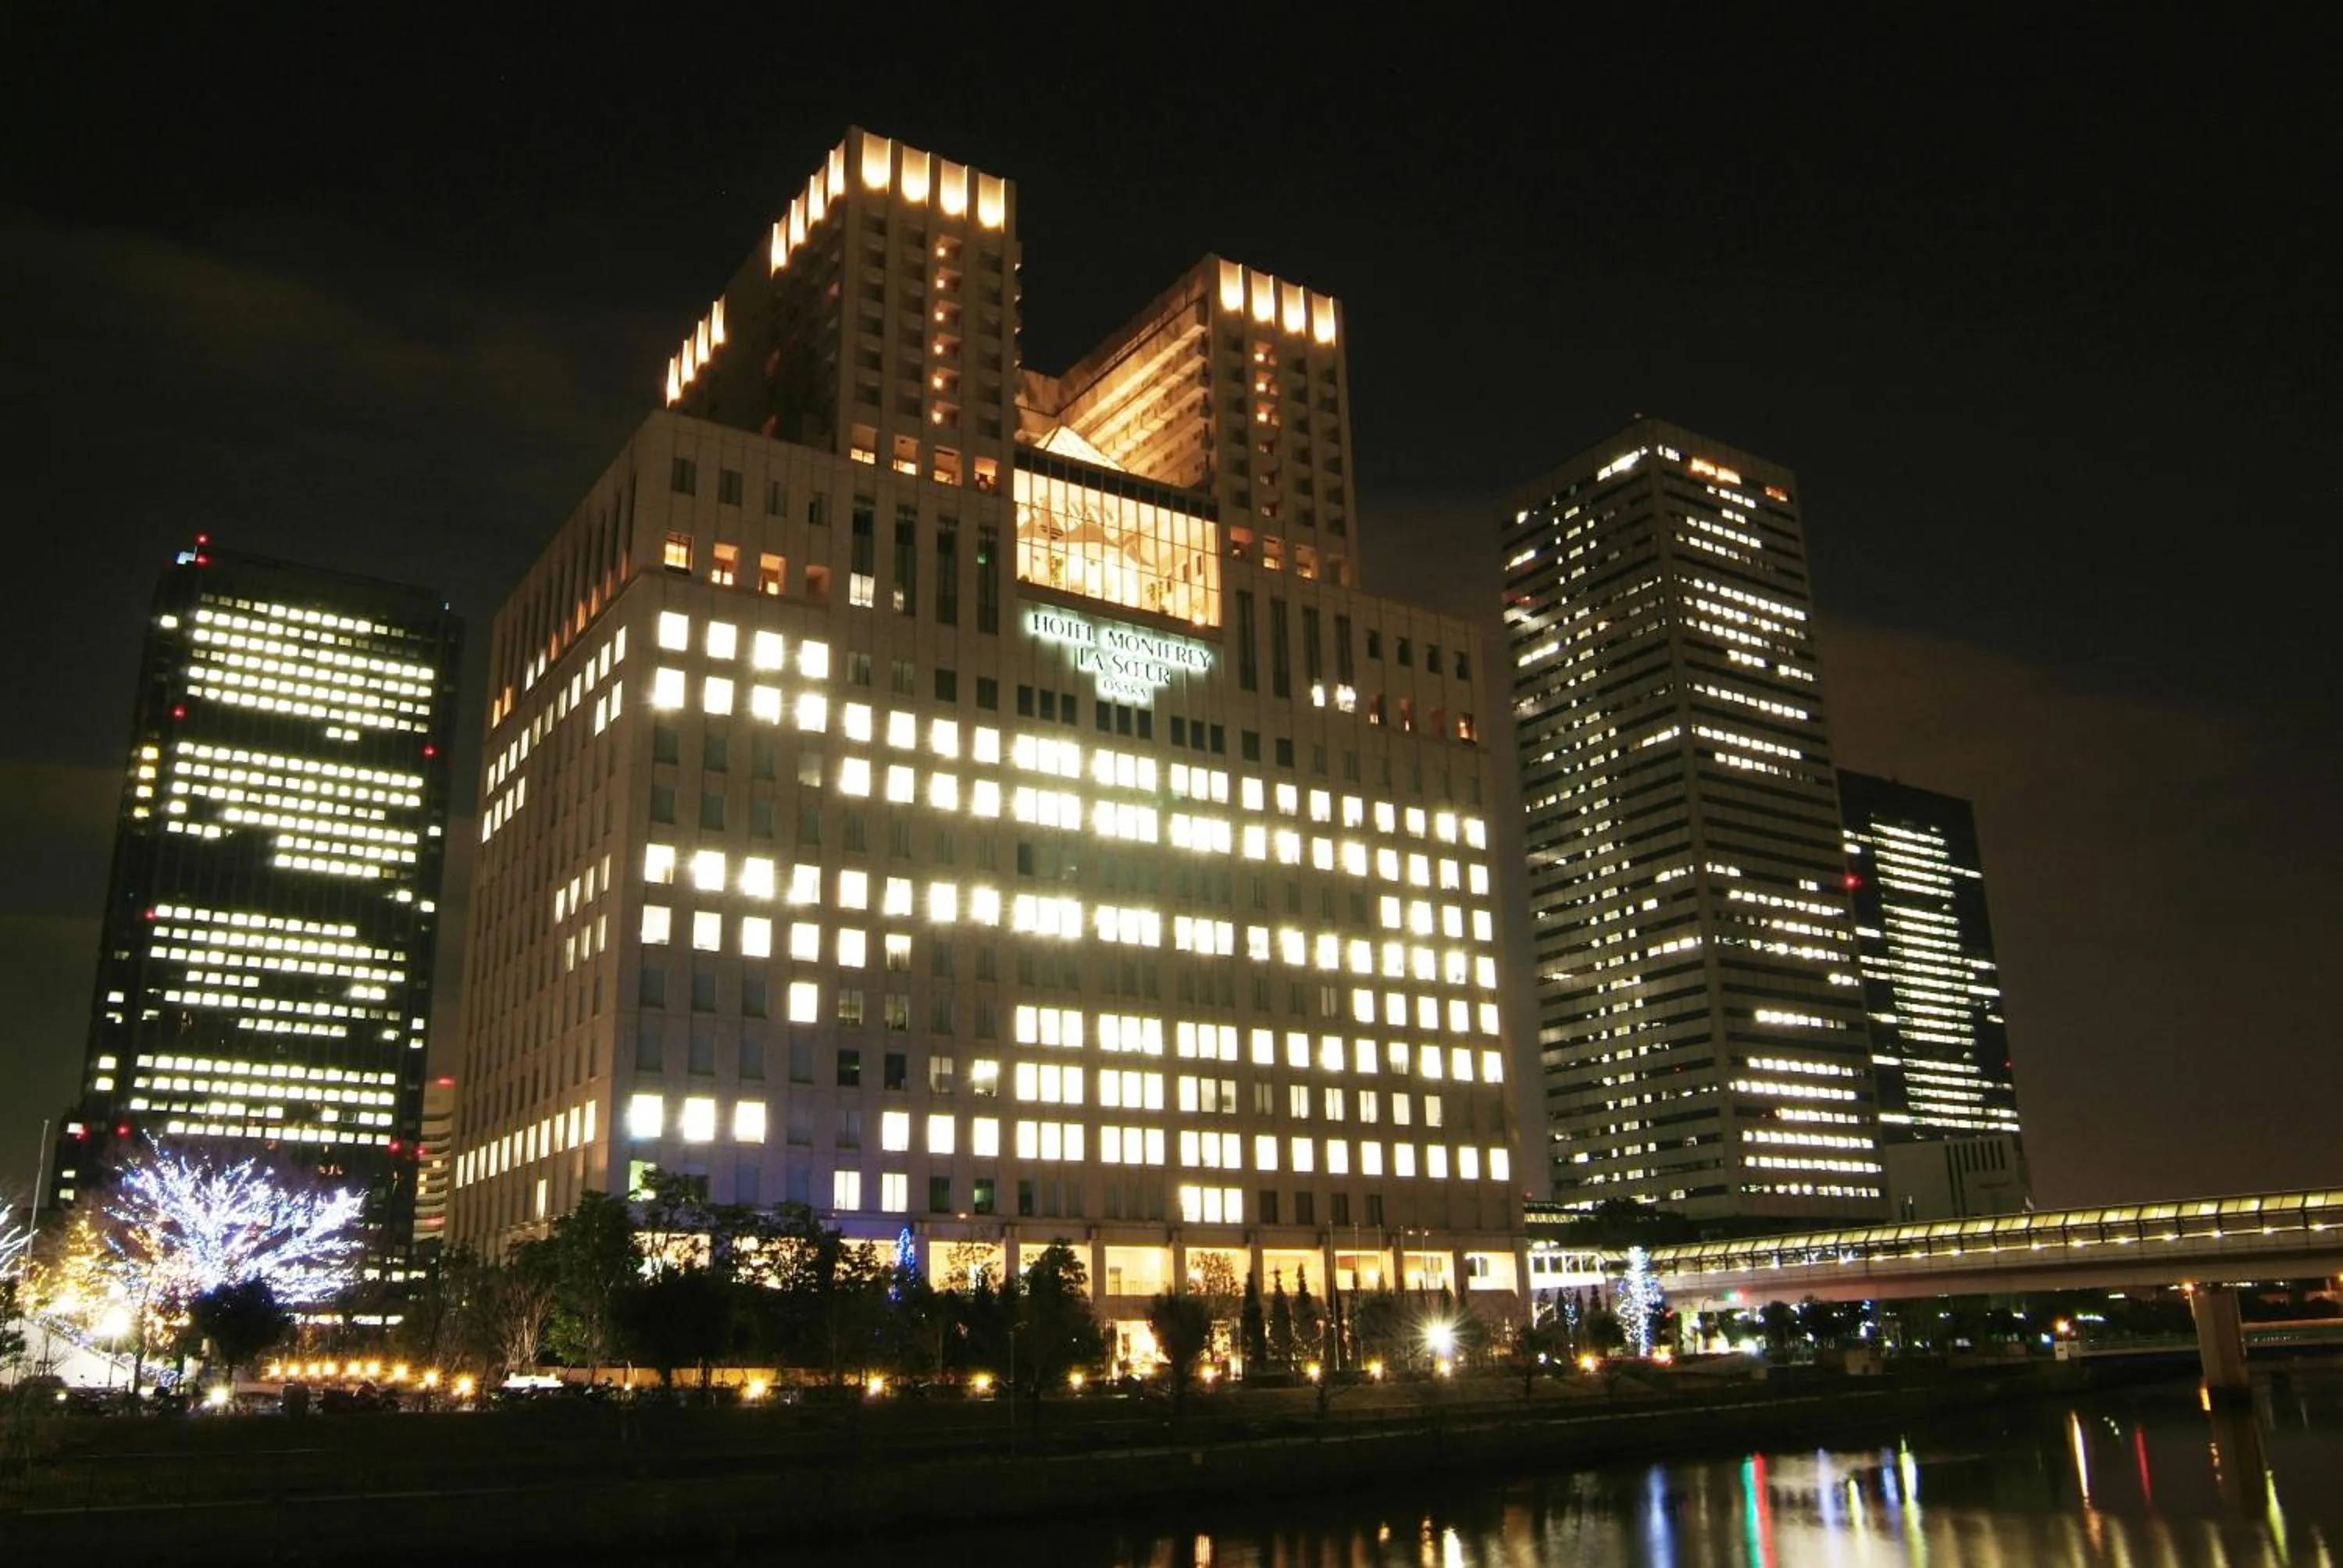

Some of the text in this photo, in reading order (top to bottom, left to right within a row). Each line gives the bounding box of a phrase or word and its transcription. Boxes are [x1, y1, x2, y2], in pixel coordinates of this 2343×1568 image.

[1033, 613, 1211, 668] HOTEL MONTEREY
[1079, 647, 1104, 671] LA
[1103, 678, 1147, 698] OSAKA
